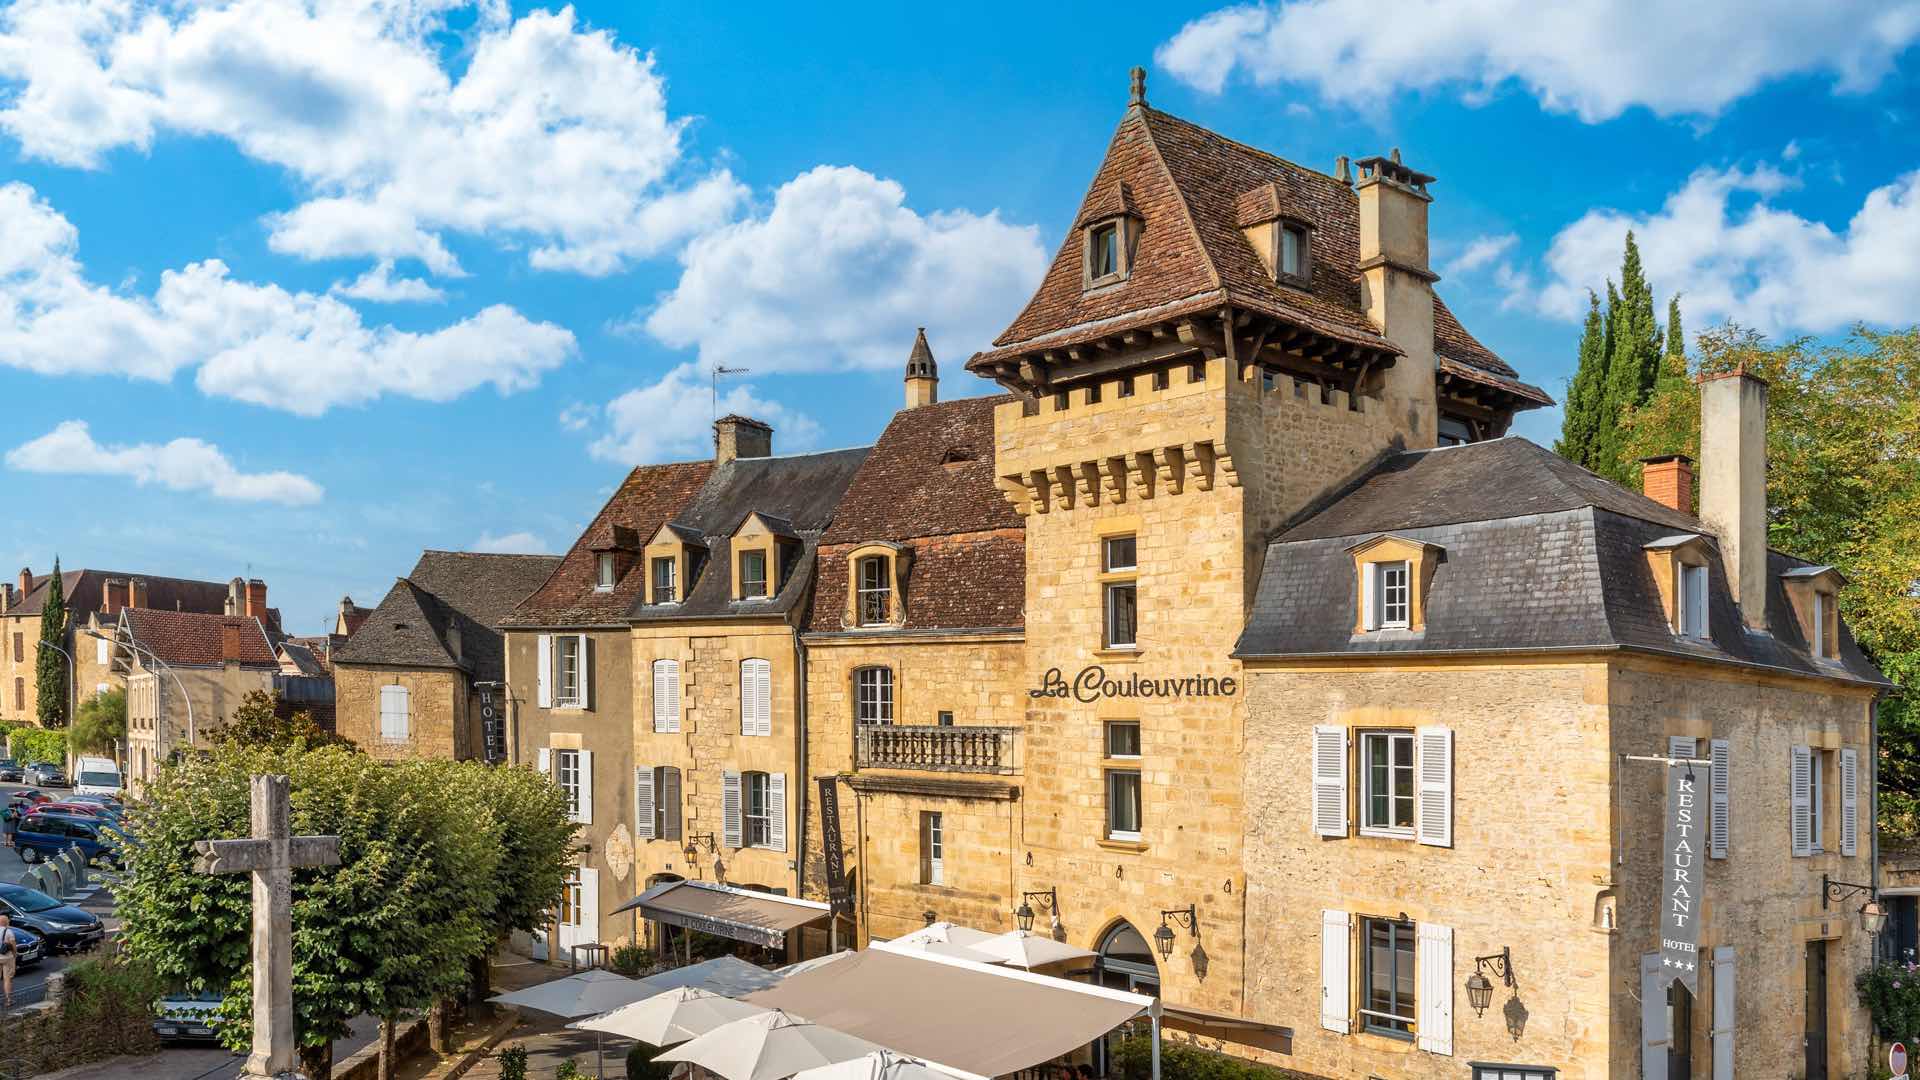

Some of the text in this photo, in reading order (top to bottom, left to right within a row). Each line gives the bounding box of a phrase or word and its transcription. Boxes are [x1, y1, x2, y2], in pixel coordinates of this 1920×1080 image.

[1029, 665, 1236, 704] La Couleuvrine
[482, 692, 496, 760] HOTEL
[824, 788, 842, 880] RESTAURANT
[1672, 779, 1695, 928] RESTAURANT
[1663, 938, 1696, 953] HOTEL
